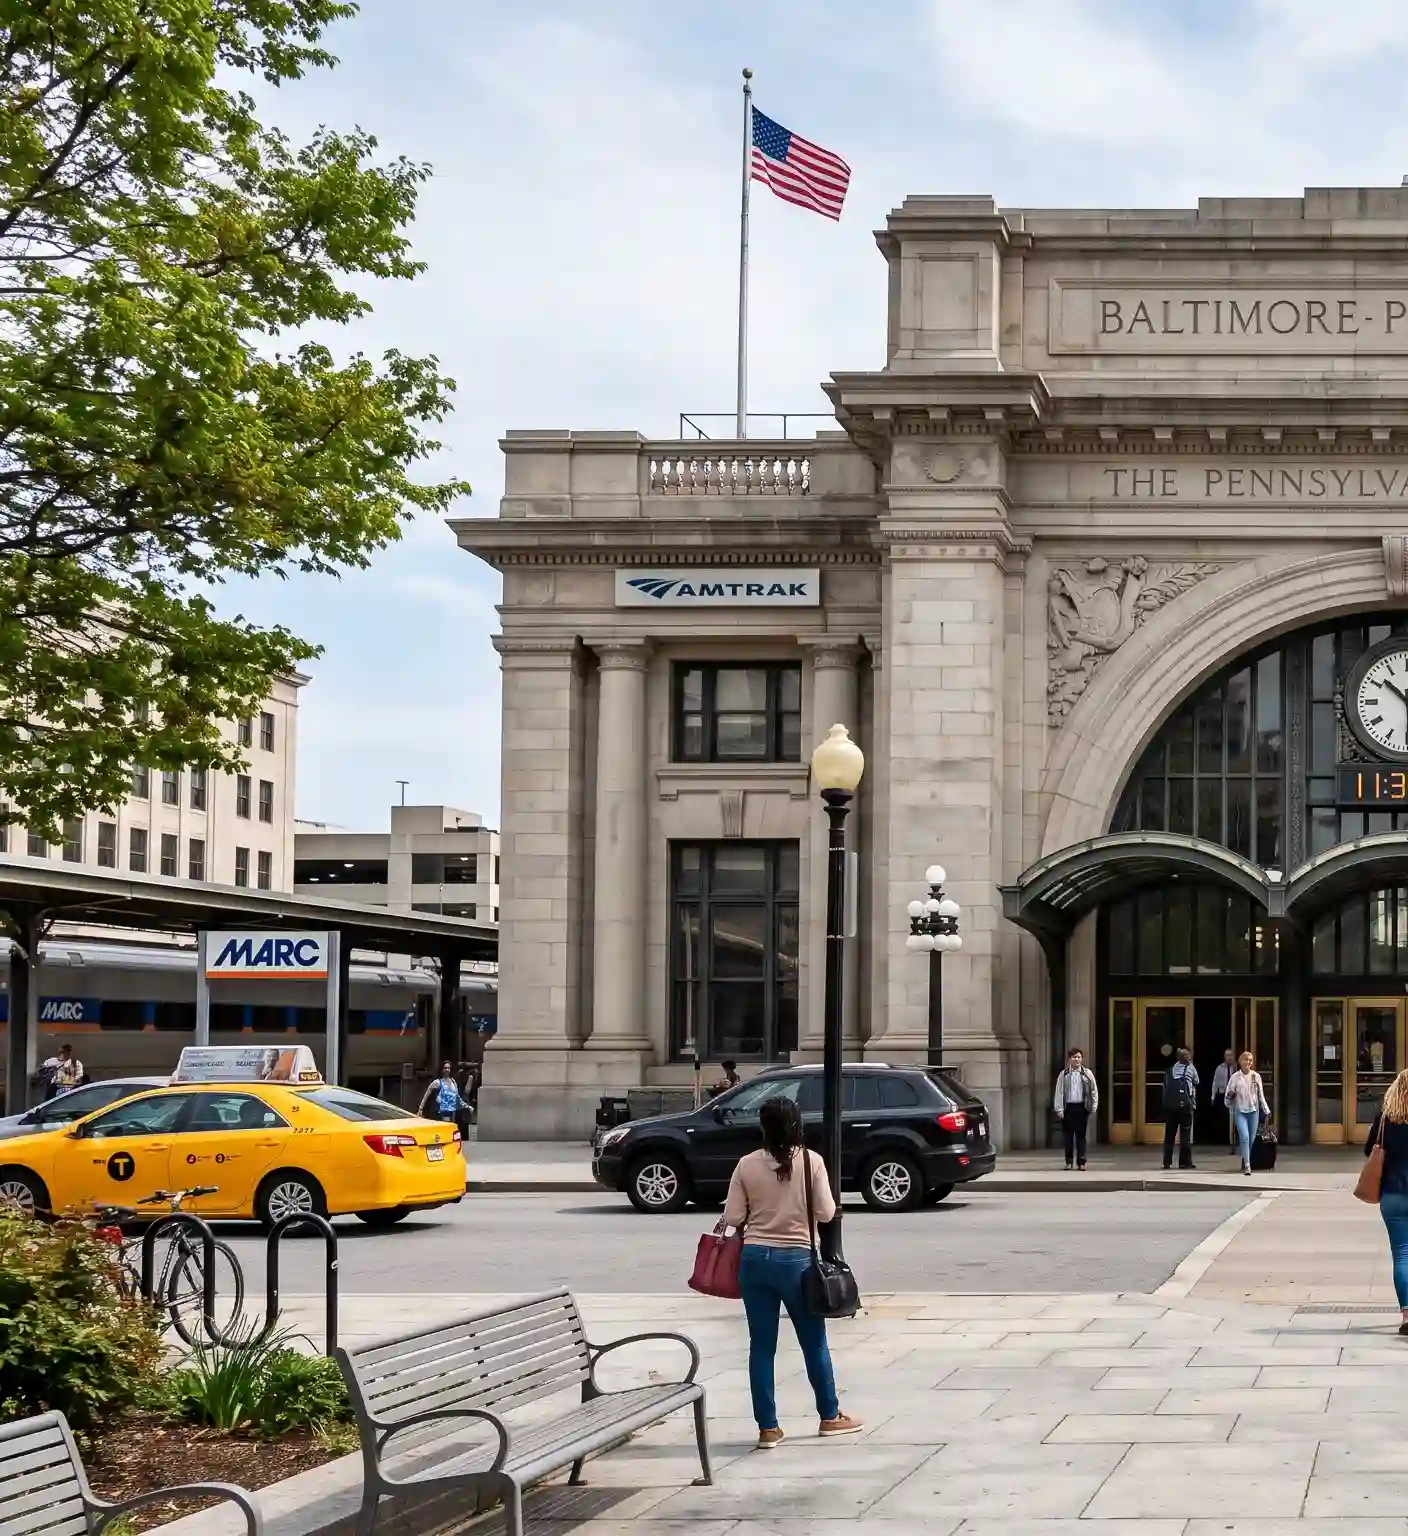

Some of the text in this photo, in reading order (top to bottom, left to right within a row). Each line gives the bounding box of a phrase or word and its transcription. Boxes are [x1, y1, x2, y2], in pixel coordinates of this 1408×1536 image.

[1103, 468, 1180, 497] THE
[676, 583, 807, 596] AMTRAK
[213, 938, 320, 967] MARC
[41, 1001, 84, 1020] MARC
[113, 1157, 130, 1176] T
